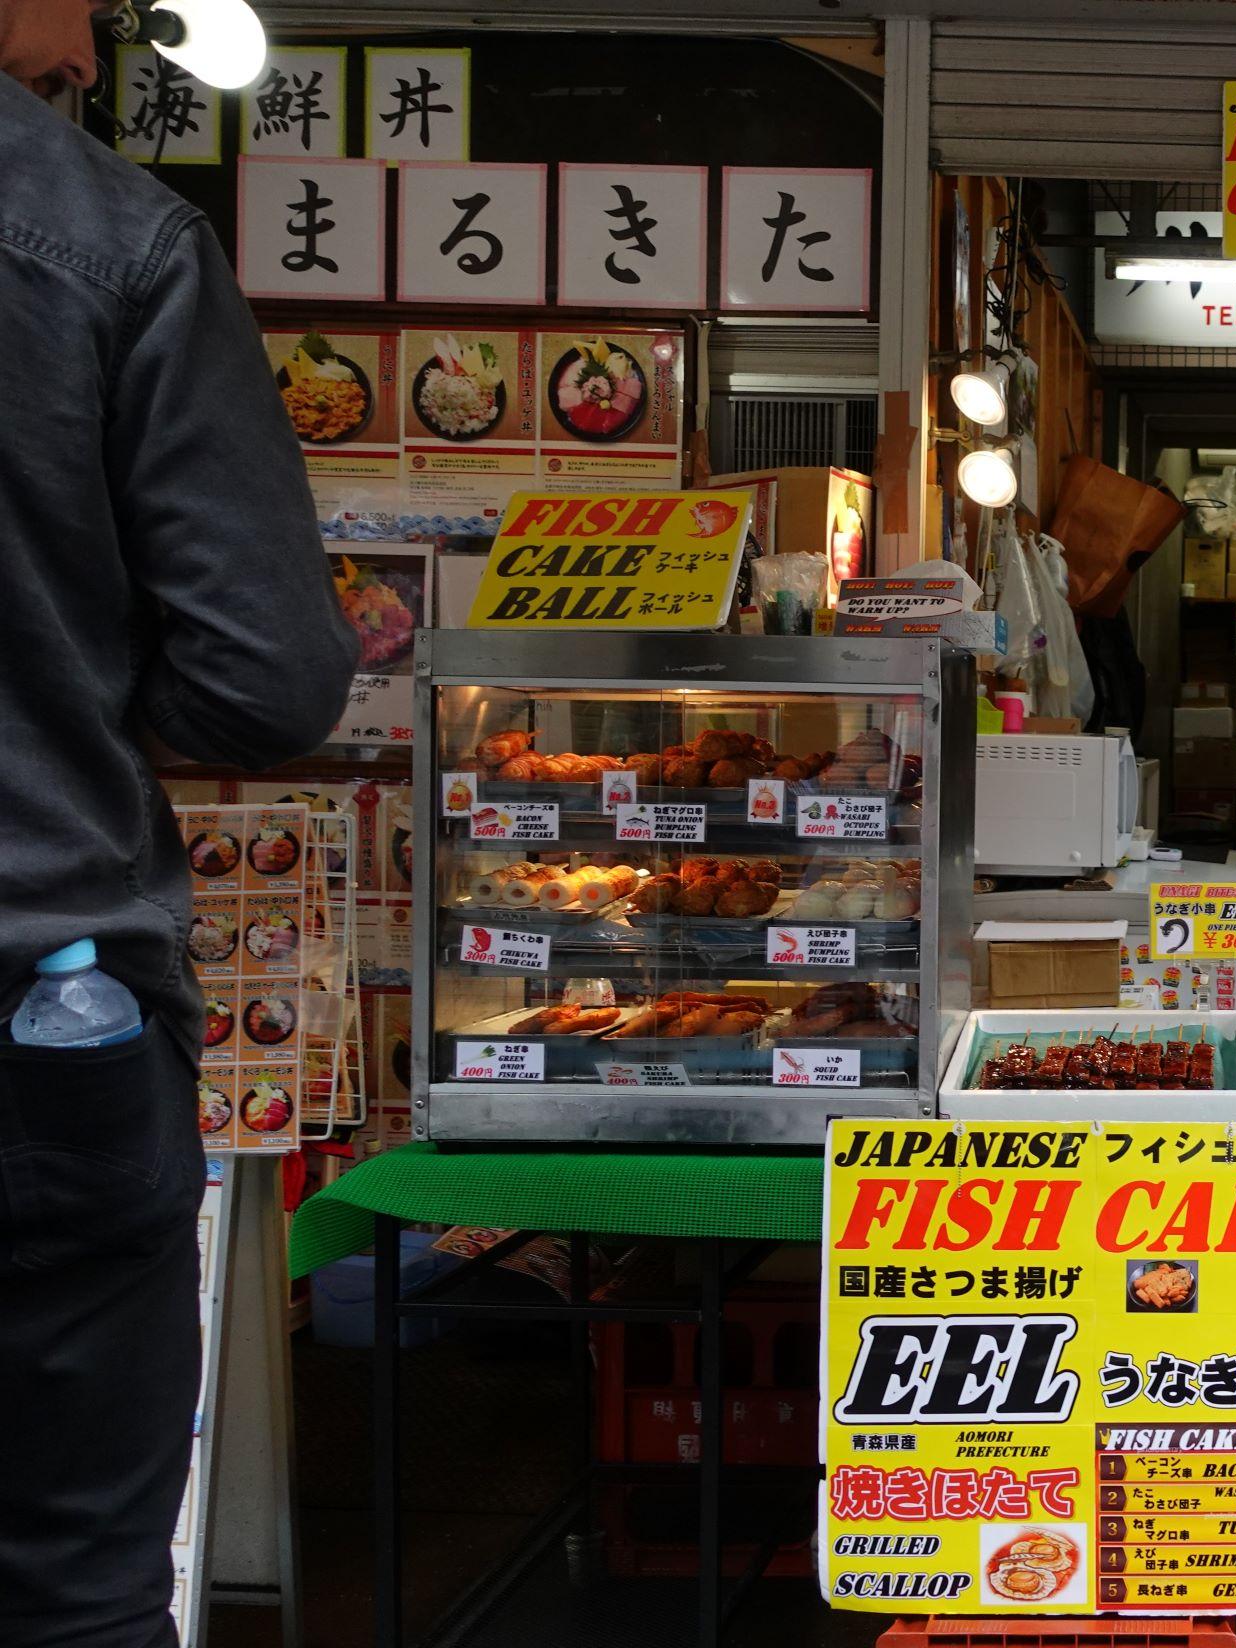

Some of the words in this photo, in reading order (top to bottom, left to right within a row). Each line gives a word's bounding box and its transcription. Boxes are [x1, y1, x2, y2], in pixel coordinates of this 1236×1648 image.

[132, 66, 453, 151] 海鮮丼
[281, 178, 836, 284] まるきた
[500, 498, 684, 537] FISH
[496, 545, 659, 578] CAKE
[657, 550, 730, 563] フィッシュ
[656, 562, 697, 574] ケーキ
[486, 586, 640, 620] BALL
[642, 592, 714, 604] フィッシュ
[848, 598, 864, 606] DO
[868, 598, 892, 606] YOU
[894, 598, 927, 606] WANT
[929, 598, 945, 606] TO
[639, 603, 682, 616] ボール
[474, 826, 506, 837] 500円
[533, 831, 555, 839] CAKE
[619, 828, 651, 839] 500円
[804, 825, 835, 836] 500円
[1154, 902, 1216, 916] うなぎ小串
[500, 949, 538, 959] CHIKUWA
[772, 953, 804, 963] 500円
[499, 957, 519, 966] FISH
[520, 959, 543, 968] CAKE
[461, 1068, 493, 1078] 400円
[518, 1071, 540, 1079] CAKE
[779, 1074, 810, 1084] 300円
[834, 1131, 1088, 1168] JAPANESE
[834, 1178, 1083, 1251] FISH
[839, 1265, 1083, 1299] 国産さつま揚げ
[832, 1313, 1081, 1425] EEL
[852, 1434, 917, 1451] 青森県産
[955, 1431, 1014, 1443] AOMORI
[1104, 1429, 1177, 1450] FISH
[955, 1446, 1050, 1457] PREFECTURE
[1108, 1461, 1116, 1475] 1
[1135, 1457, 1181, 1467] ベーコン
[1147, 1467, 1193, 1479] チーズ串
[830, 1465, 1081, 1522] 焼きほたて
[1108, 1491, 1117, 1505] 2
[1132, 1488, 1154, 1498] たこ
[1144, 1499, 1201, 1510] わさび団子
[1107, 1522, 1117, 1536] 3
[1132, 1518, 1155, 1530] ねぎ
[1145, 1530, 1190, 1541] マグロ串
[833, 1535, 942, 1557] GRILLED
[1134, 1548, 1156, 1558] えび
[1107, 1553, 1117, 1567] 4
[1145, 1559, 1179, 1570] 団子串
[833, 1572, 973, 1600] SCALLOP
[1108, 1583, 1117, 1597] 5
[1137, 1585, 1188, 1596] 長ねぎ串
